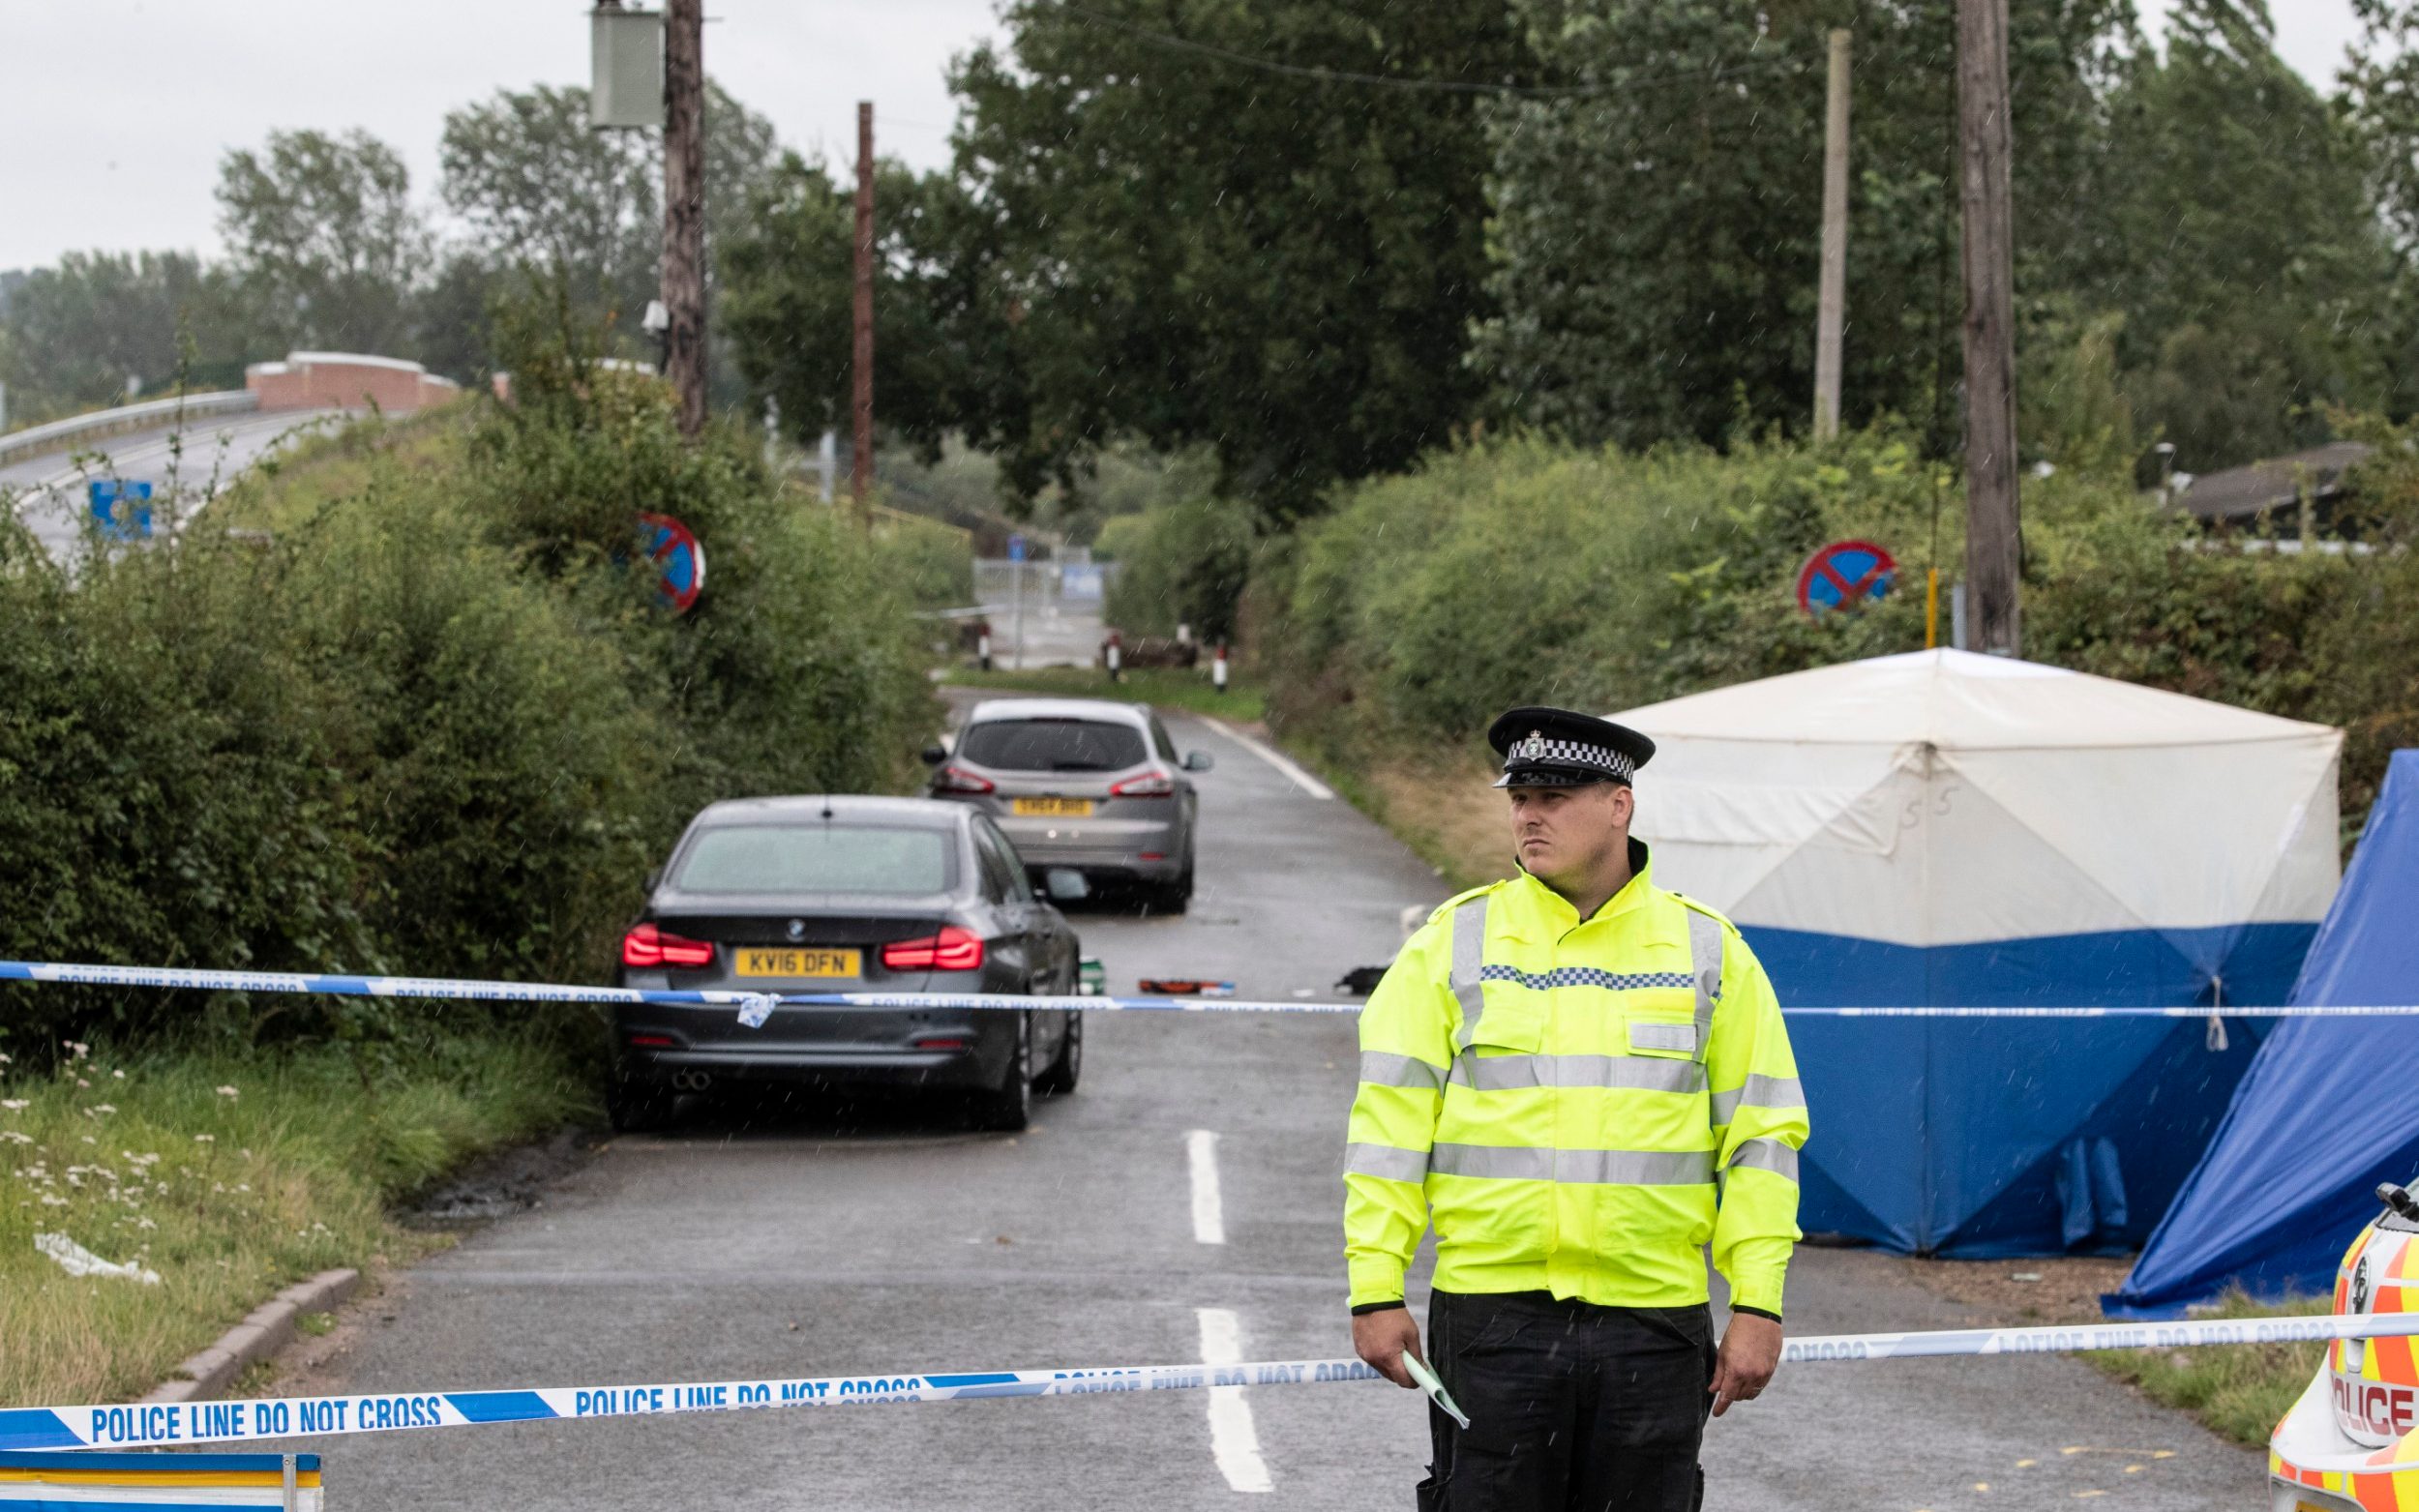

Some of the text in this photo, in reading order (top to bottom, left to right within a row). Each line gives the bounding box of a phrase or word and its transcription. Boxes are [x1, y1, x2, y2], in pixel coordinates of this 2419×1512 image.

[749, 952, 847, 973] KV16 DFN
[92, 1396, 442, 1442] POLICE LINE DO NOT CROSS
[2333, 1377, 2417, 1437] OLICE
